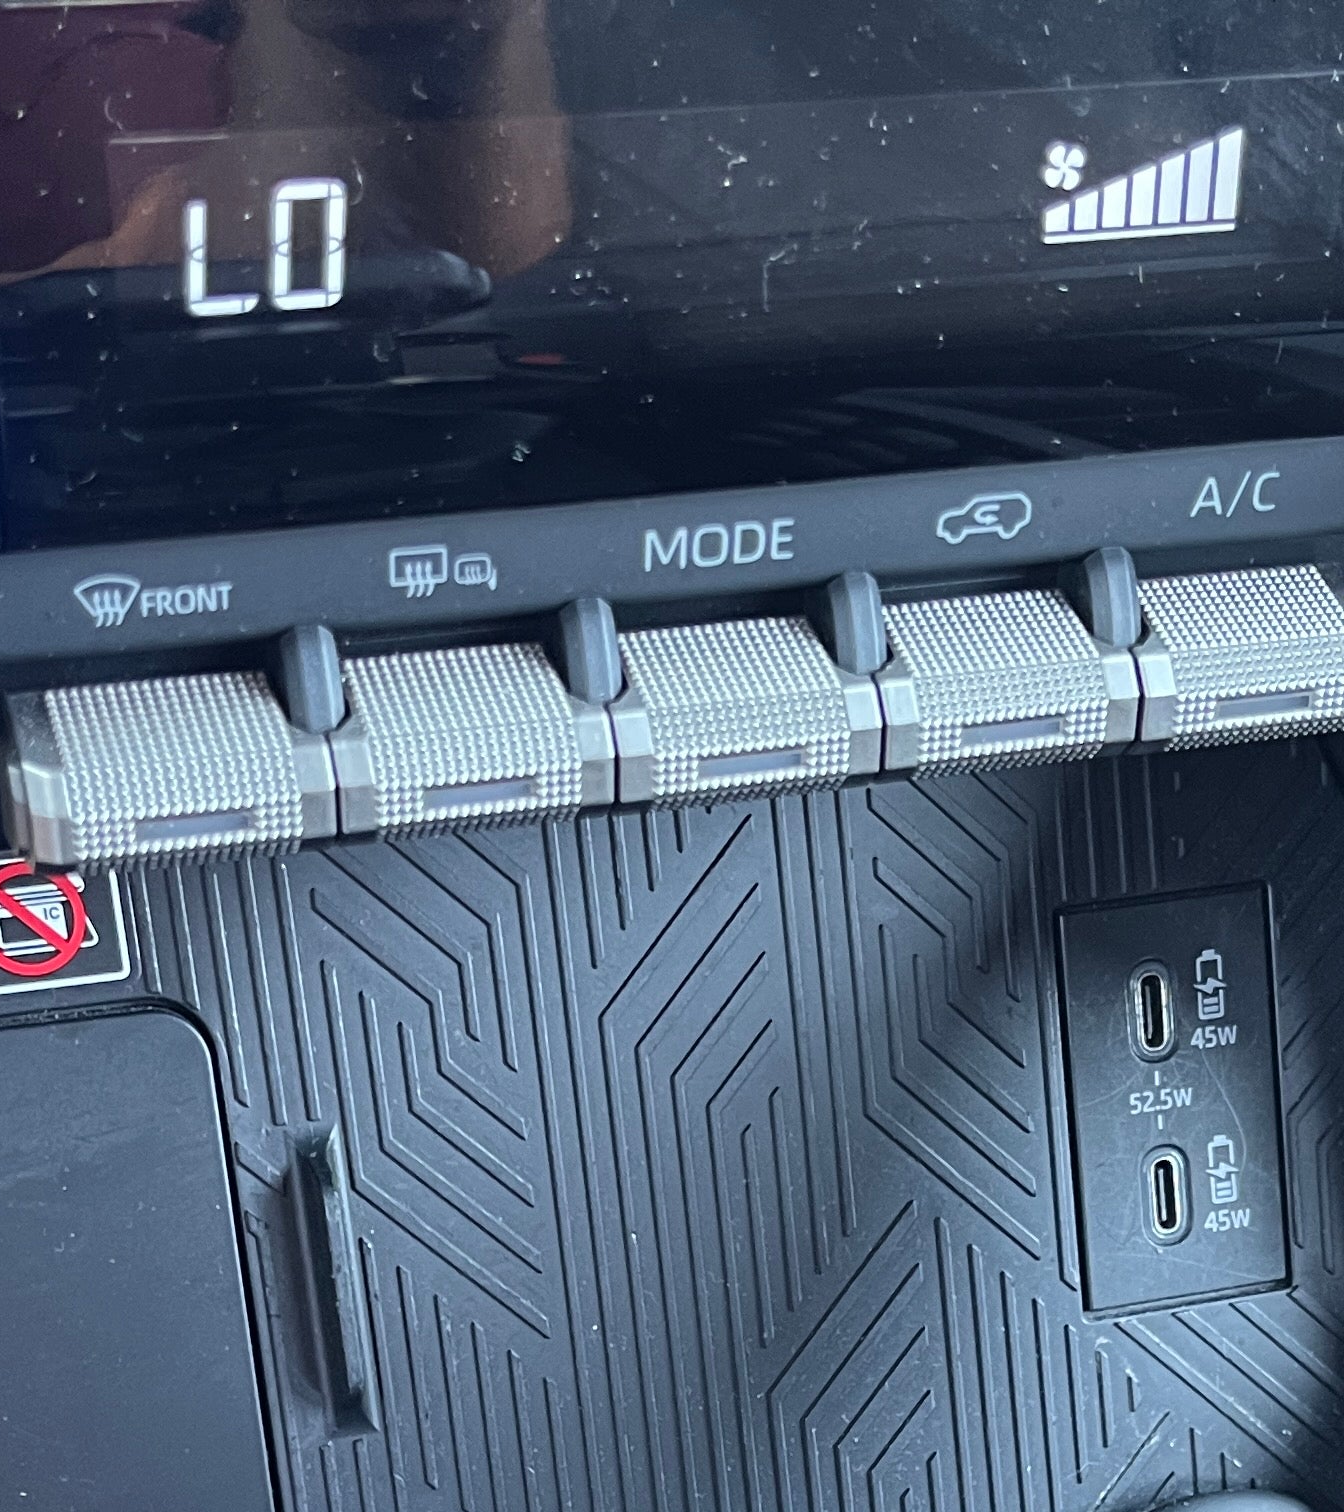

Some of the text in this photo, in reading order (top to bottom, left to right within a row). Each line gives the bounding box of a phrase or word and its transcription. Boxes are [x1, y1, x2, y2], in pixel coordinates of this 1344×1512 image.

[1189, 470, 1281, 518] A/C
[643, 518, 796, 573] MODE
[140, 582, 233, 618] FRONT
[42, 905, 61, 921] IC
[1190, 1024, 1238, 1050] 45W
[1129, 1087, 1193, 1115] 52.5W
[1203, 1208, 1251, 1233] 45W
